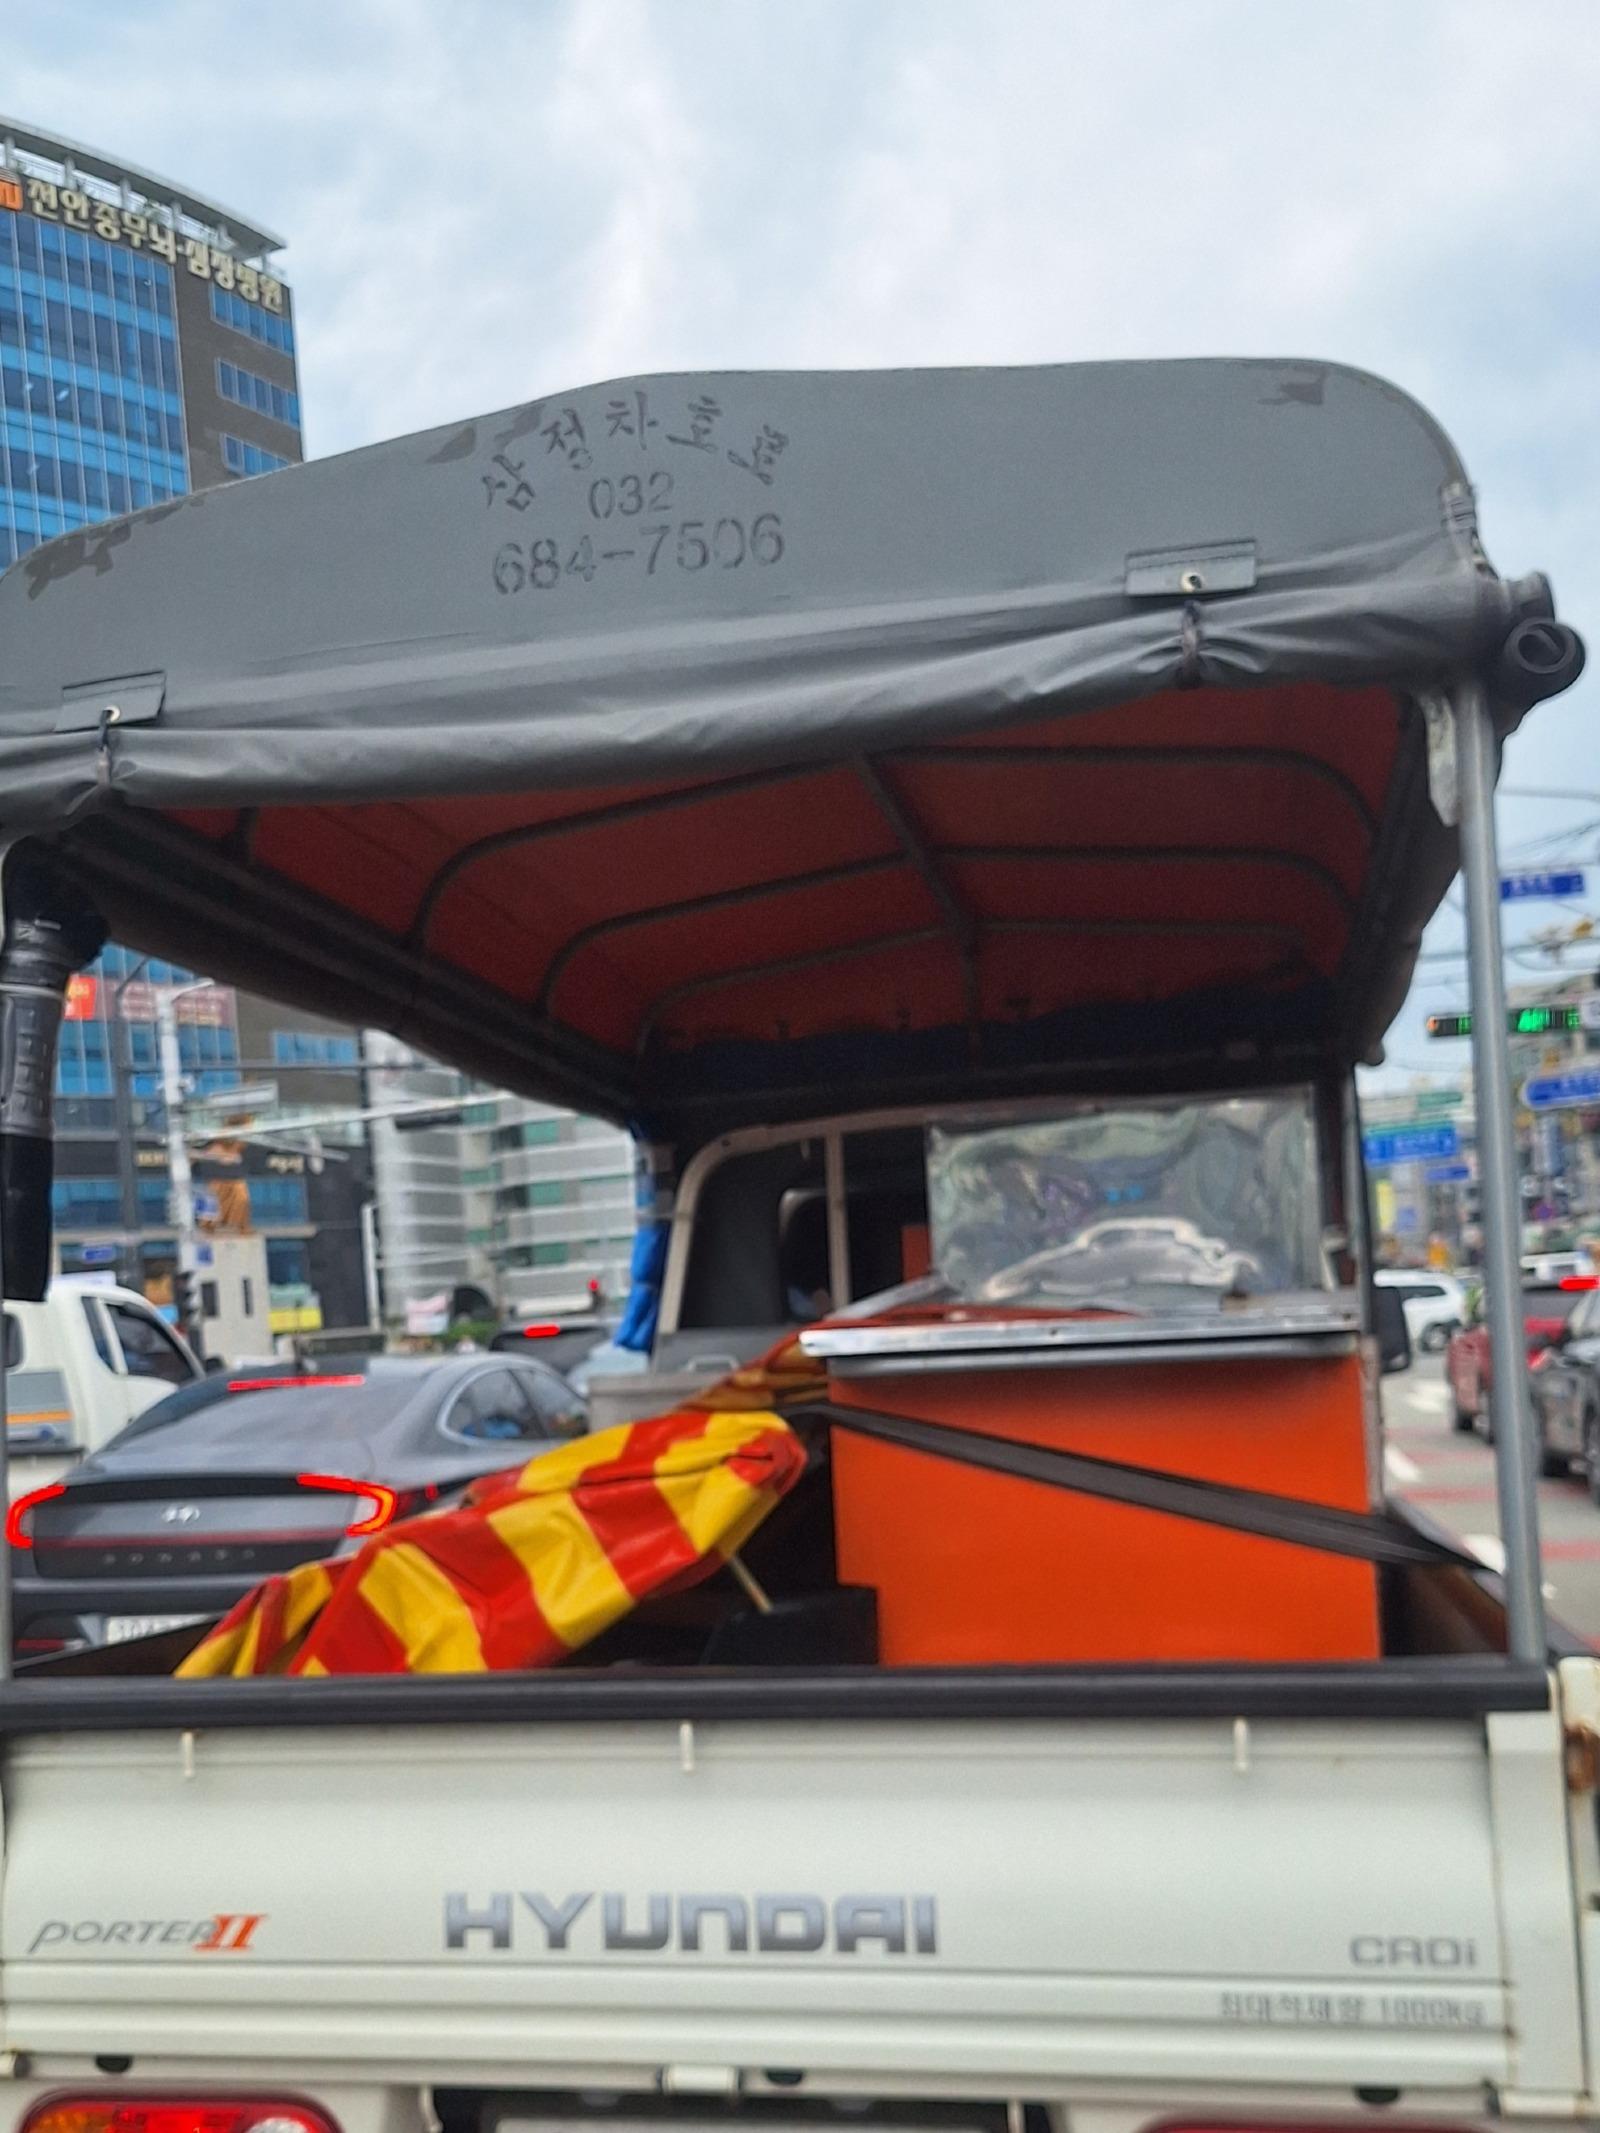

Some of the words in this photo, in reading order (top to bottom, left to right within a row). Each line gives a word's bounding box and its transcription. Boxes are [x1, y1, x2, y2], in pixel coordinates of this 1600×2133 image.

[588, 471, 675, 519] 032
[492, 512, 783, 594] 684-7506
[446, 1892, 938, 1954] HYUNDAI
